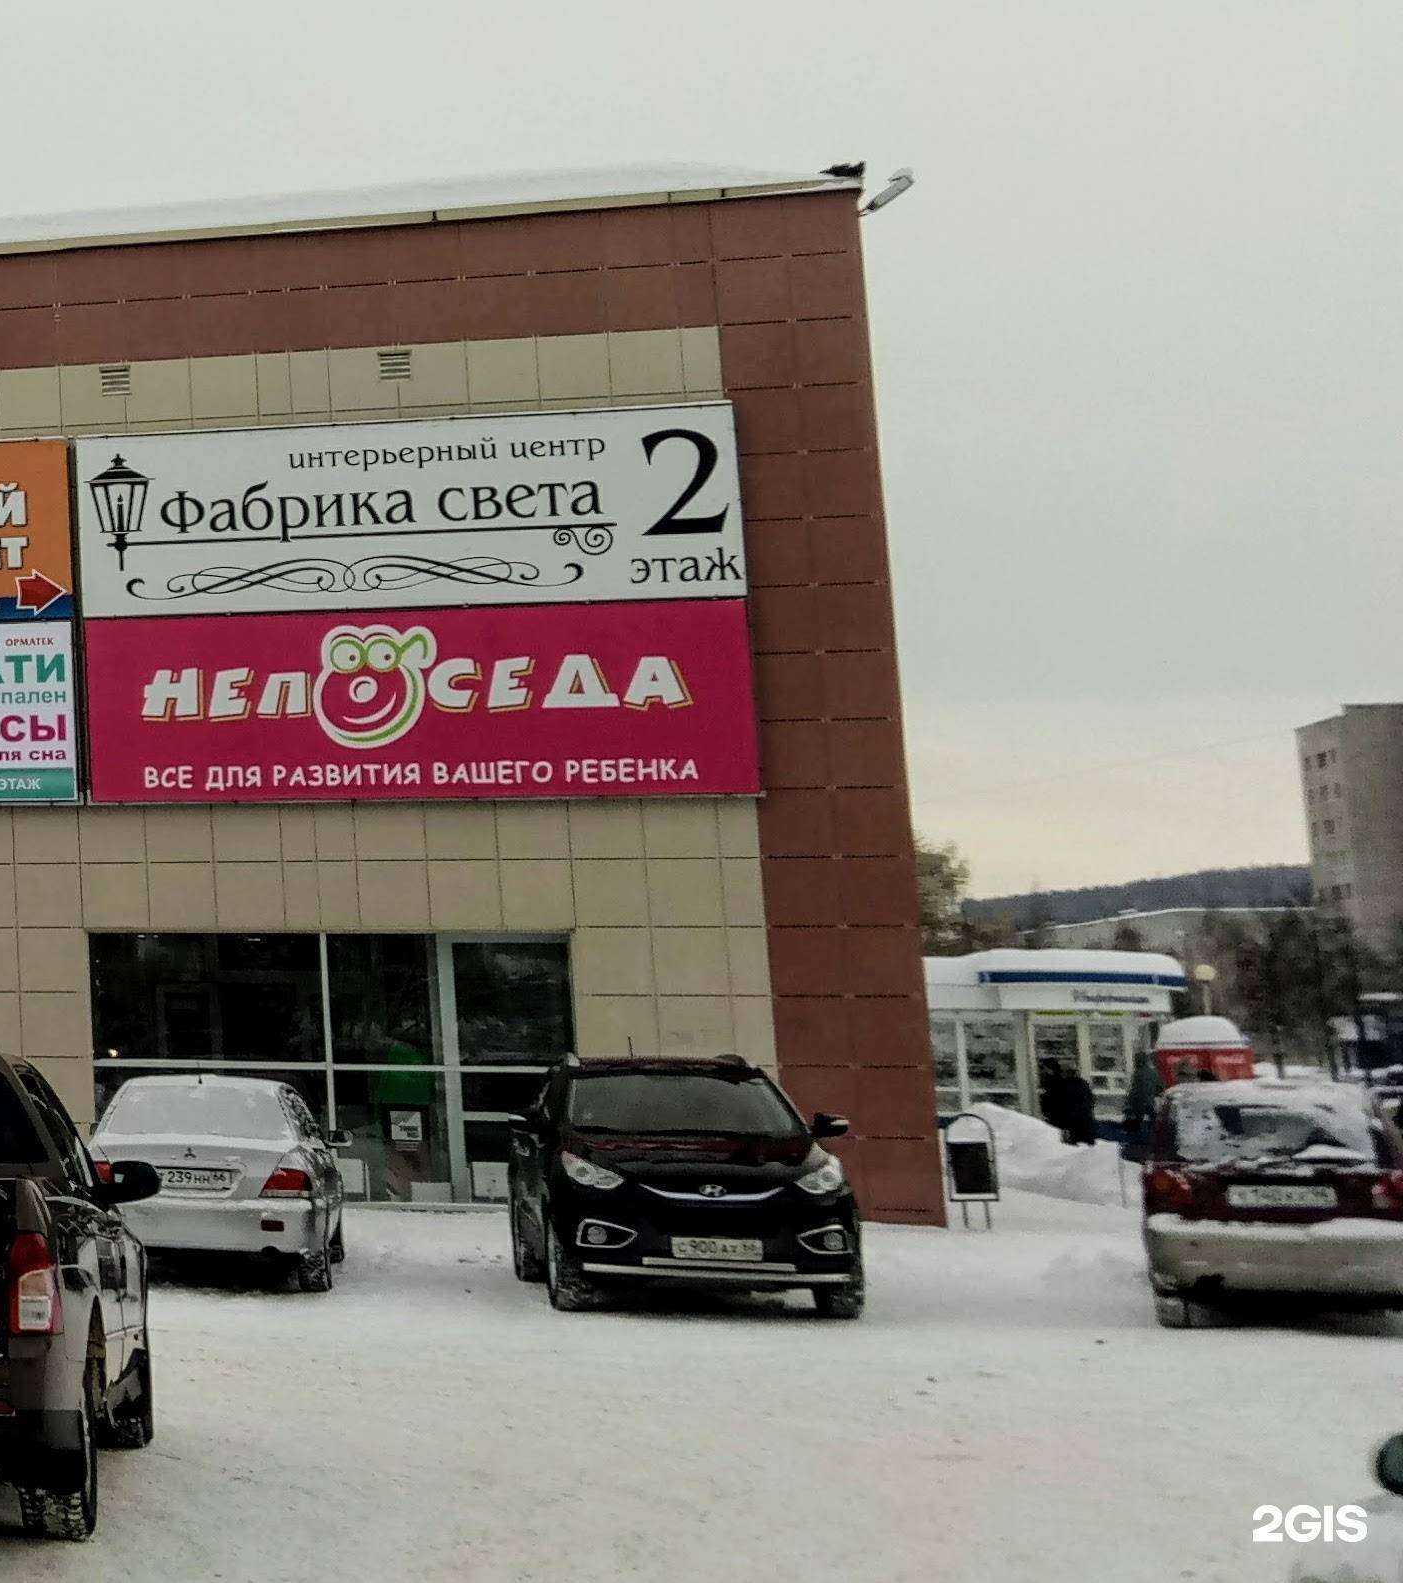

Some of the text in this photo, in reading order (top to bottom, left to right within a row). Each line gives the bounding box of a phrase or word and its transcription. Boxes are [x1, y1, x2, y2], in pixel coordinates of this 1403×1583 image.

[288, 433, 606, 474] интерьерный центр
[640, 428, 730, 536] 2
[160, 477, 604, 543] Фабрика света
[630, 546, 743, 584] этаж
[5, 637, 55, 648] ОРМАТЕК
[28, 747, 67, 762] сна
[144, 757, 698, 791] ВСЕ ДЛЯ РАЗВИТИЯ ВАШЕГО РЕБЕНКА
[159, 1170, 210, 1184] 239НН
